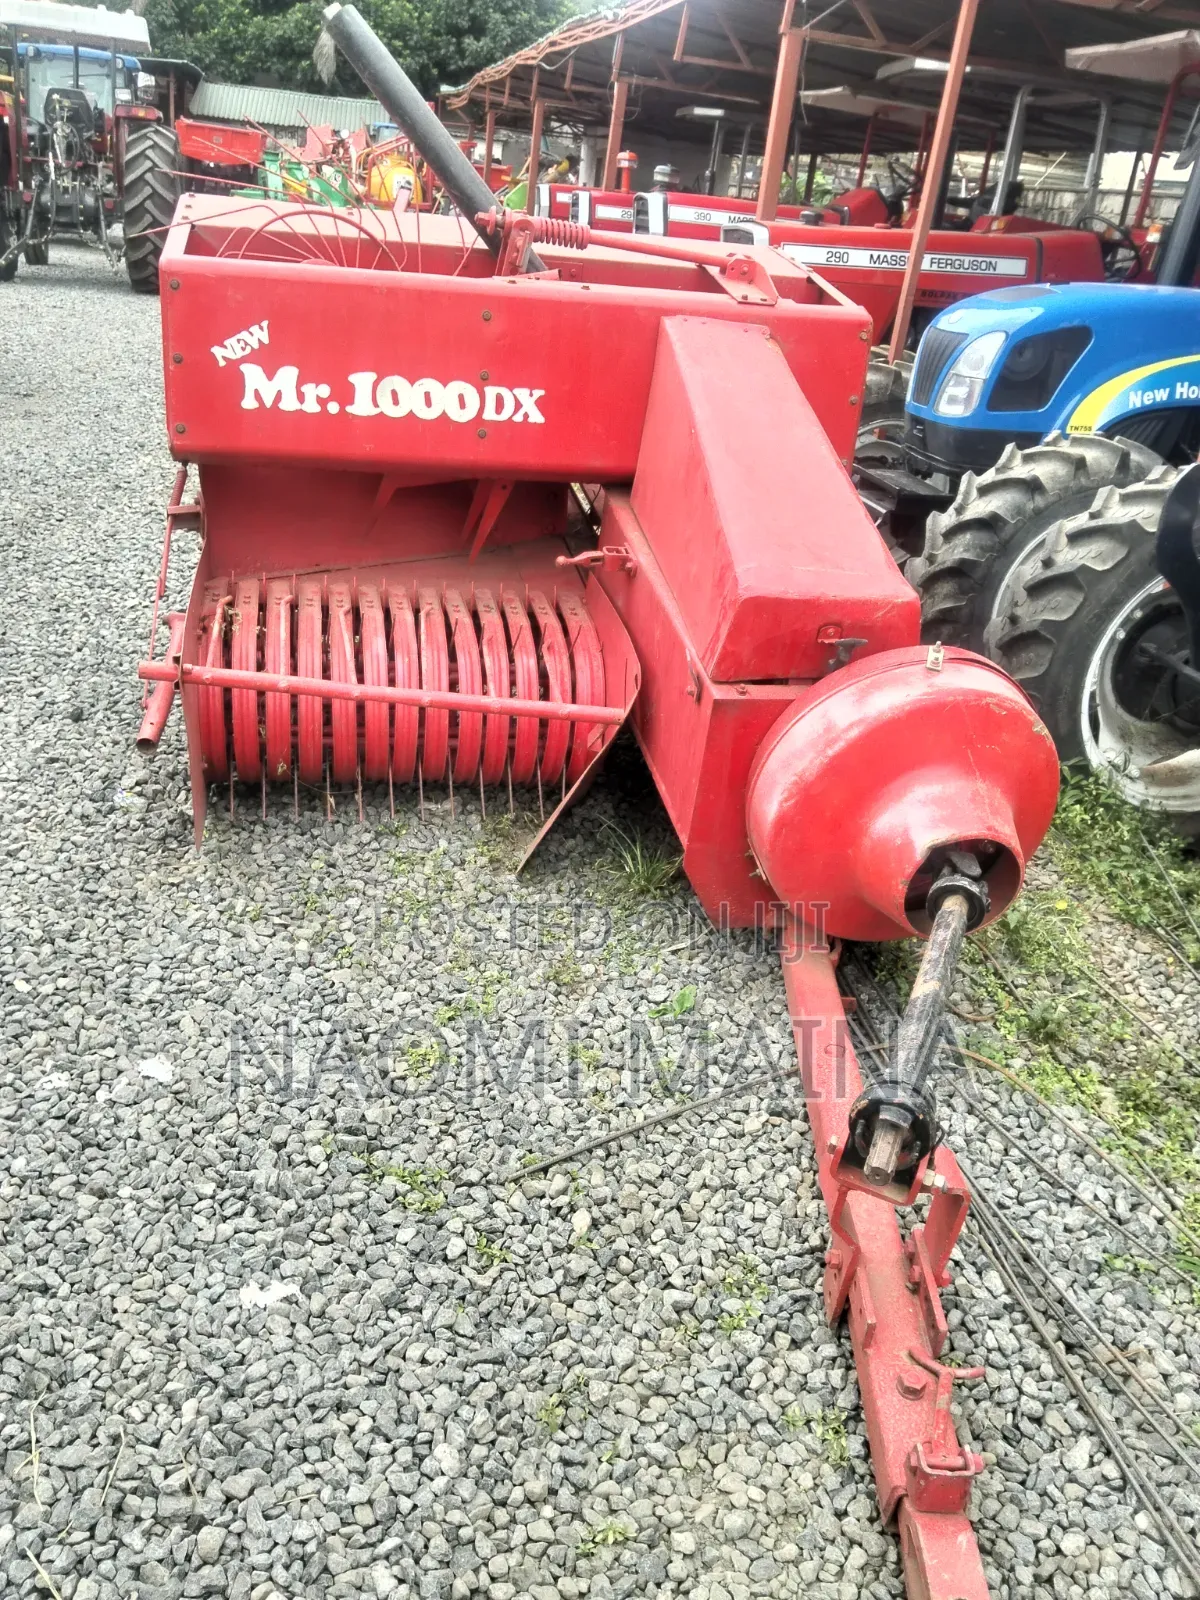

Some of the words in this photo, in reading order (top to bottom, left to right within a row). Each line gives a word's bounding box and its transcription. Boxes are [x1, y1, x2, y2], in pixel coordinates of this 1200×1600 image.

[693, 211, 712, 222] 390
[826, 250, 850, 265] 290
[869, 253, 925, 267] MASS
[929, 257, 999, 272] FERGUSON
[210, 319, 270, 367] NEW
[1128, 387, 1171, 409] New
